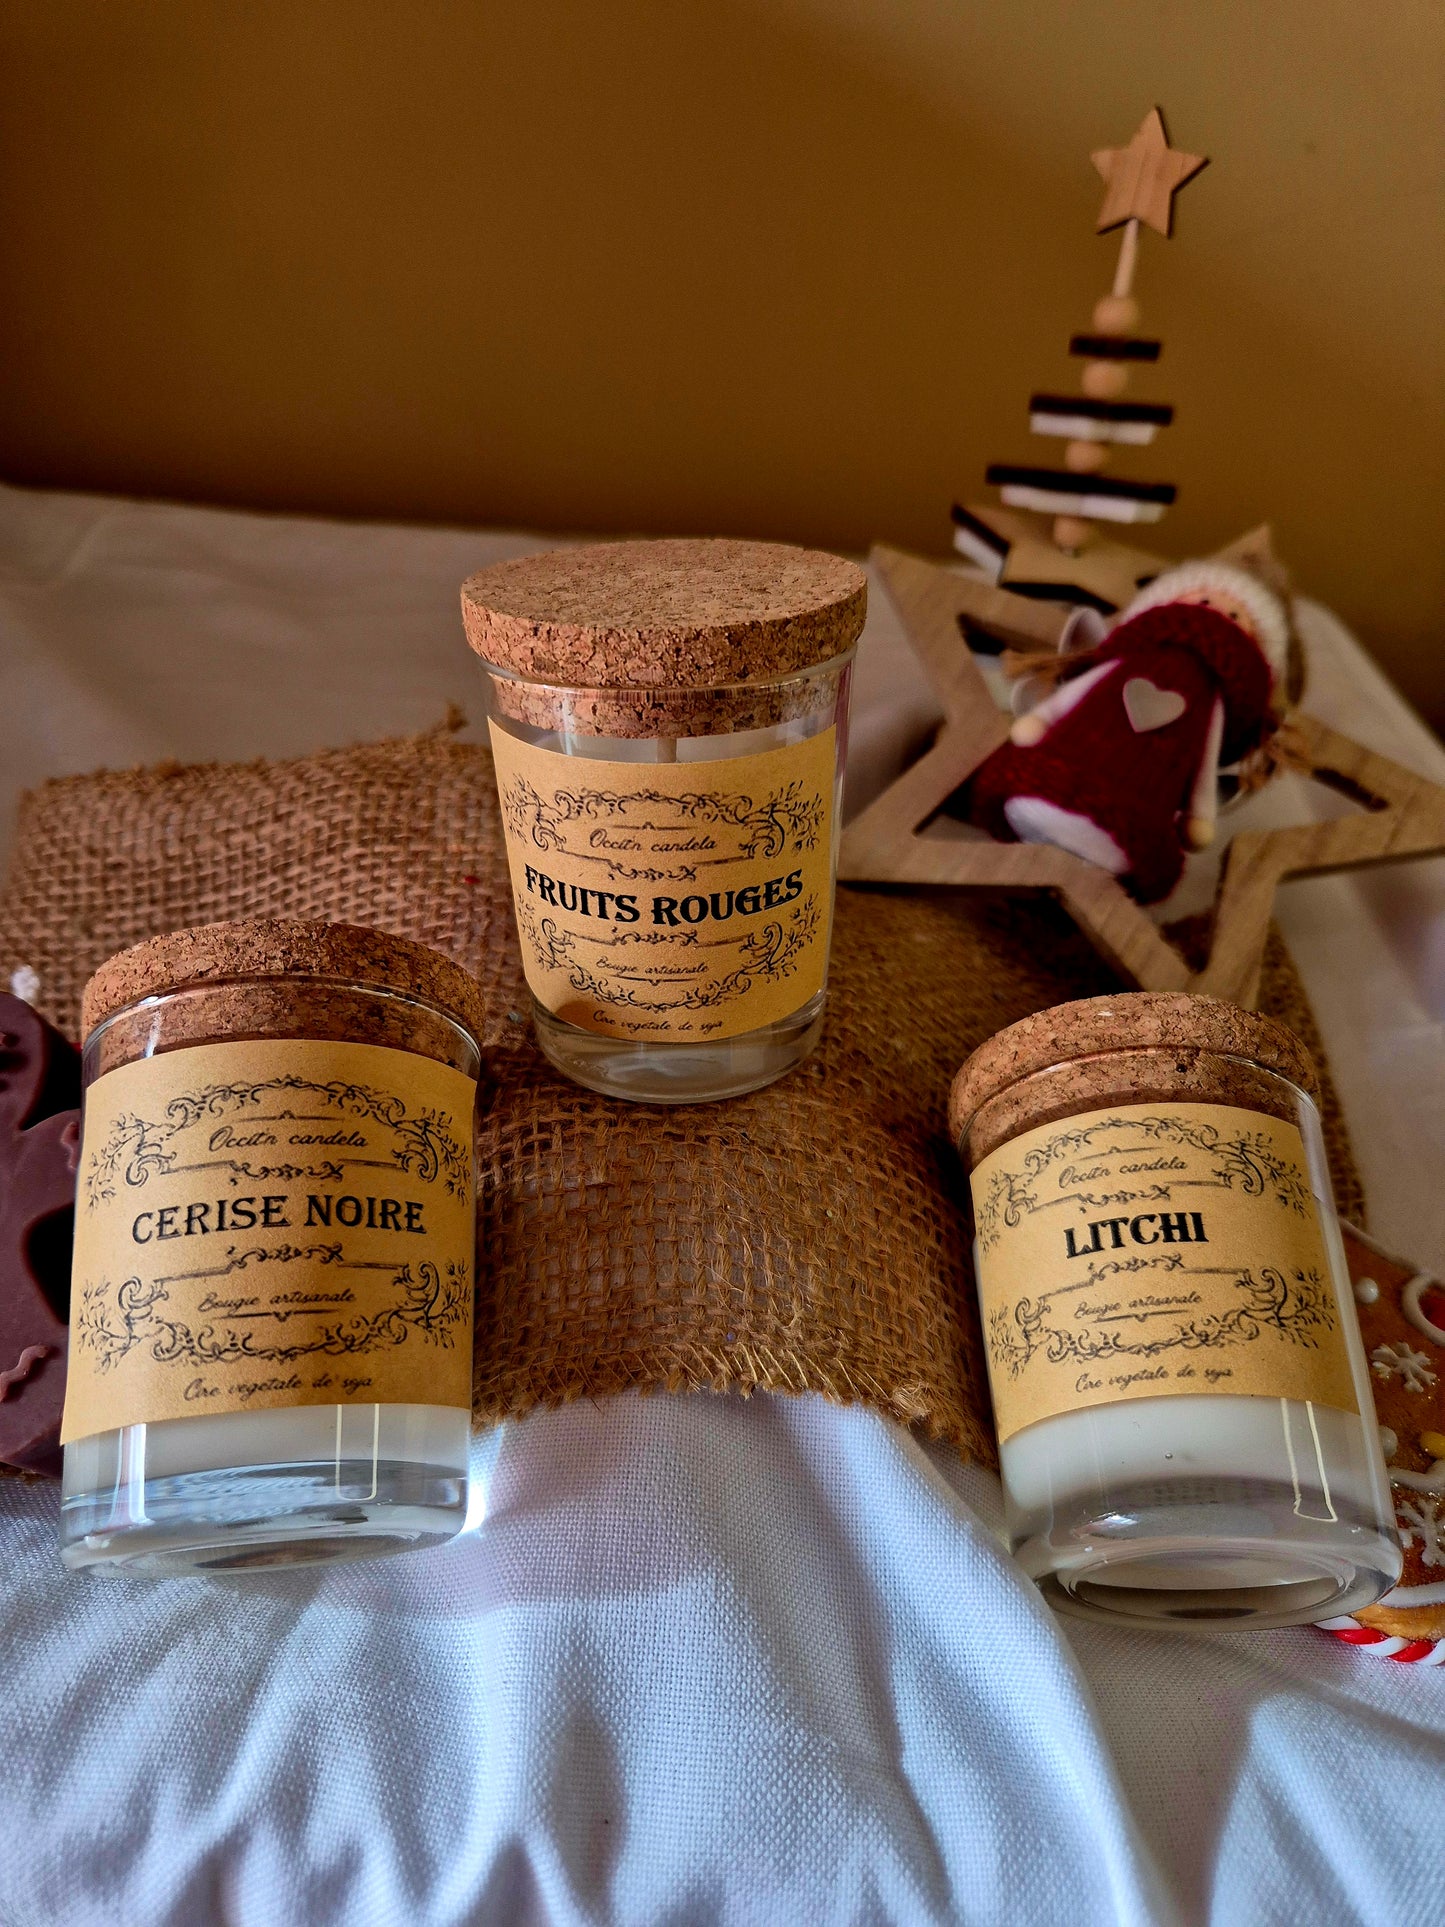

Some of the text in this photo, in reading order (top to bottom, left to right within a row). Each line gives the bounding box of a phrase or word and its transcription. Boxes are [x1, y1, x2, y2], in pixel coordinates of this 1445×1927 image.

[650, 835, 718, 852] candela
[524, 863, 804, 927] FRUITS ROUGES
[644, 961, 710, 975] artisanale
[677, 1021, 694, 1031] de
[288, 1130, 369, 1147] candela
[1119, 1156, 1188, 1175] candela
[131, 1195, 428, 1244] CERISE NOIRE
[1063, 1211, 1210, 1259] LITCHI
[268, 1288, 356, 1305] artisanale
[1128, 1291, 1202, 1309] artisanale
[1176, 1363, 1196, 1378] de
[311, 1373, 331, 1389] de
